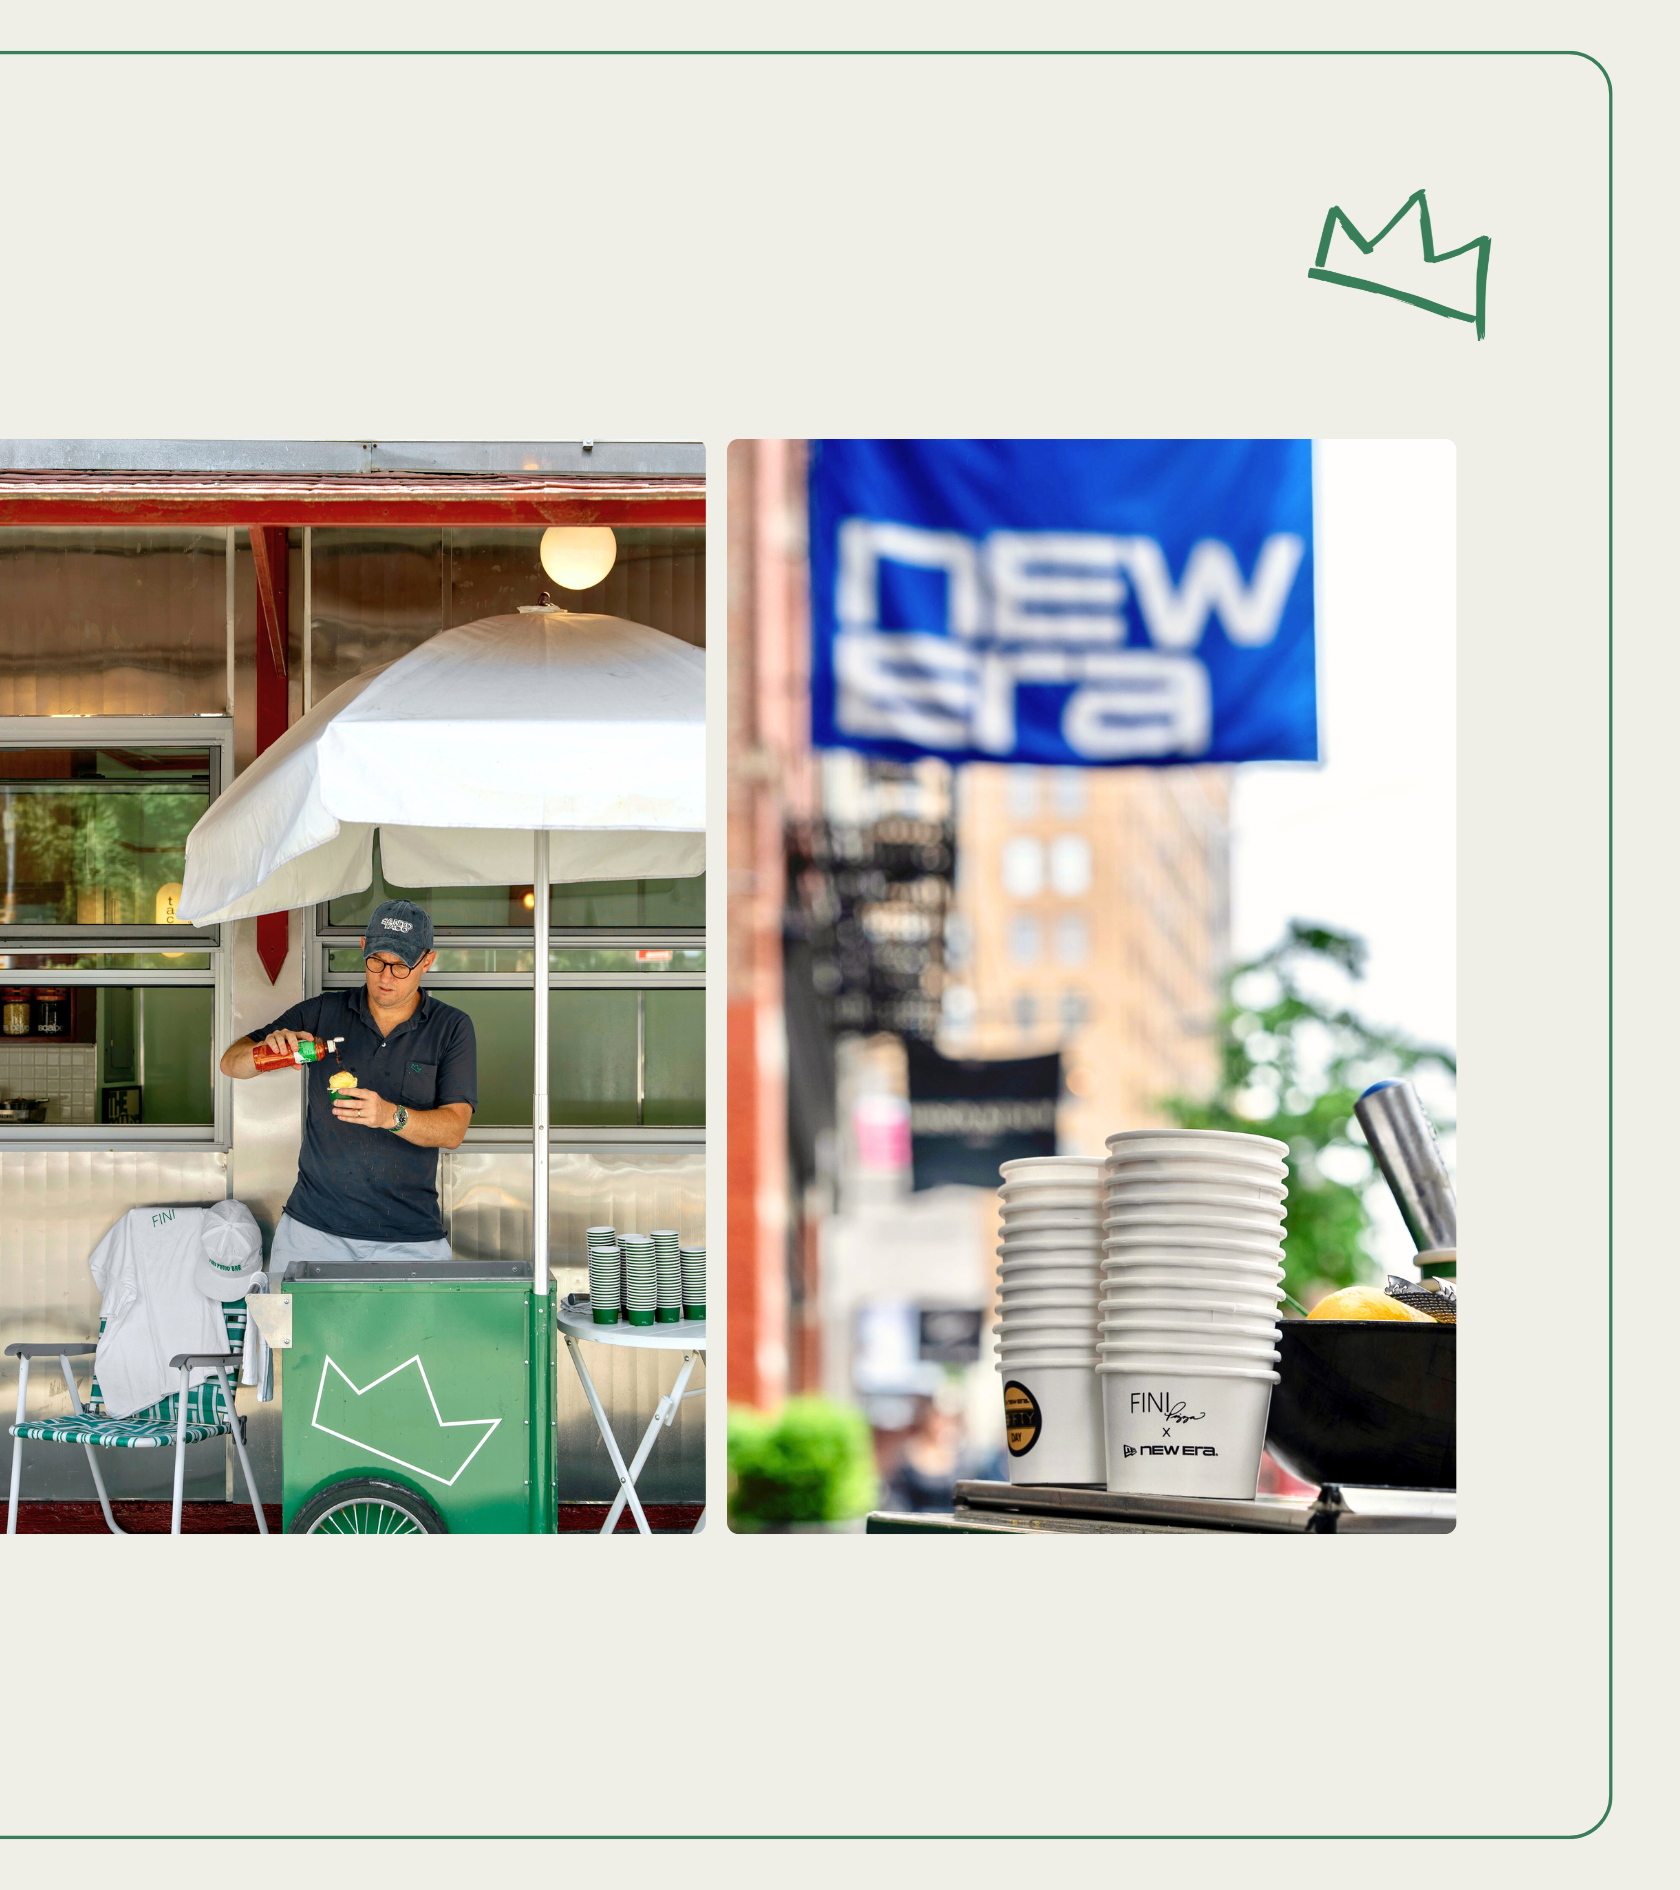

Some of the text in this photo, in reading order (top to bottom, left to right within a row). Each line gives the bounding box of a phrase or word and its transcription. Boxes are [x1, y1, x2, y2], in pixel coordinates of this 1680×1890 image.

[152, 1208, 176, 1228] FINI
[1131, 1392, 1206, 1424] FINI Pizza
[1011, 1432, 1022, 1442] DAY
